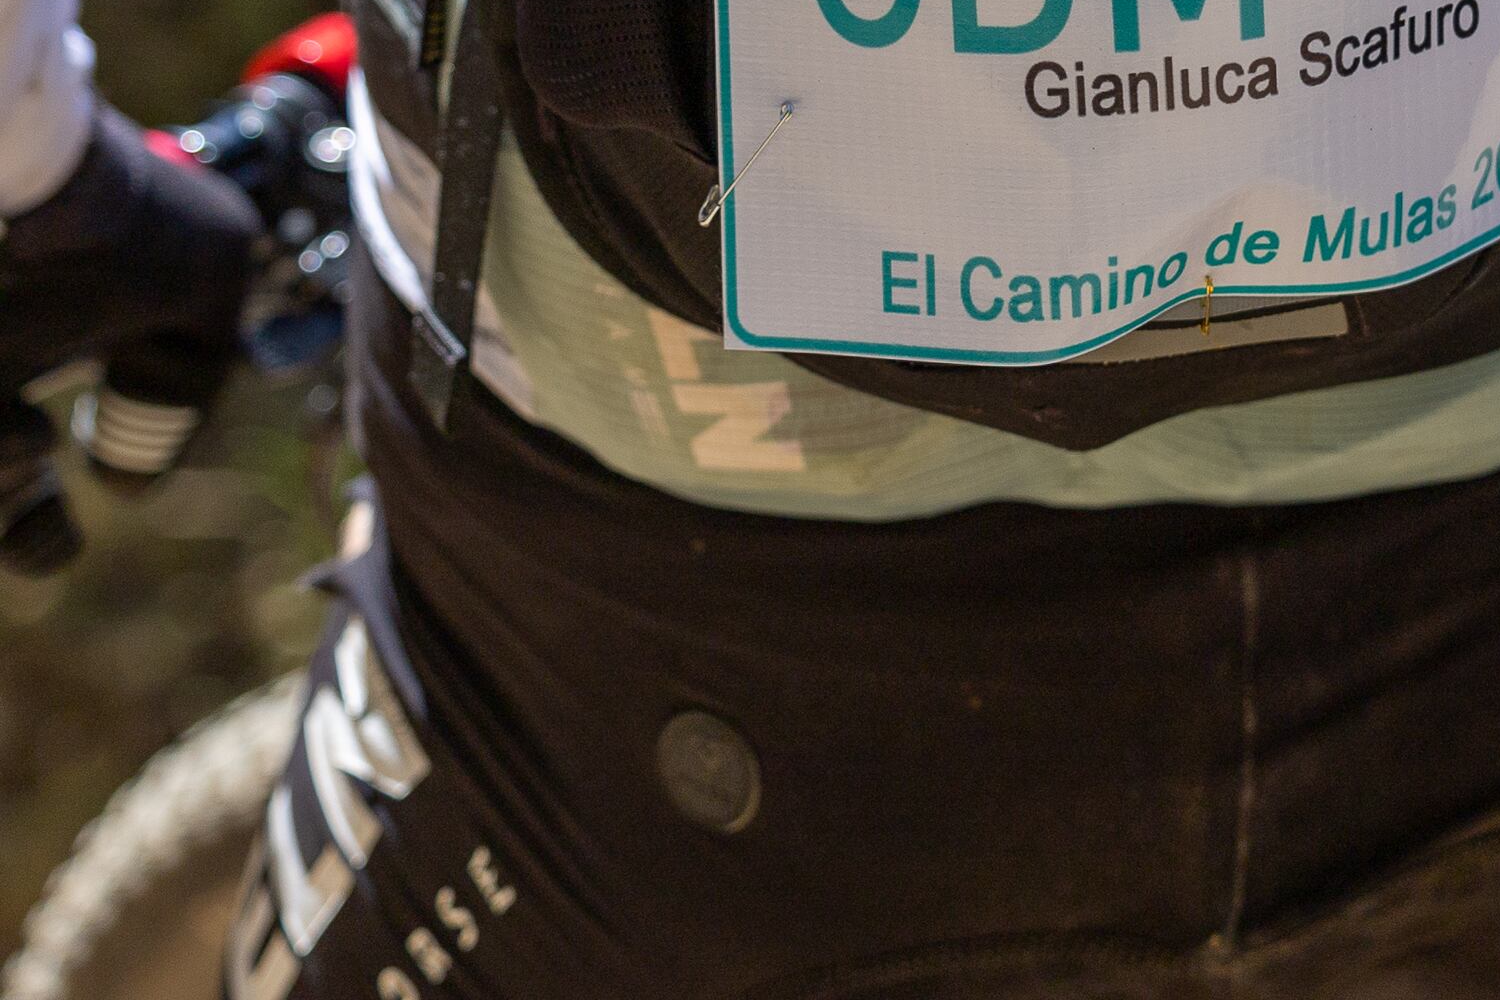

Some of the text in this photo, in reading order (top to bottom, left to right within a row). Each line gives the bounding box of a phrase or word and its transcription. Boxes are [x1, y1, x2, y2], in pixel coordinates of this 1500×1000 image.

[1024, 56, 1278, 118] Gianluca
[880, 250, 936, 316] El
[959, 250, 1188, 323] Camino
[1204, 221, 1280, 267] de
[1302, 183, 1456, 264] Mulas
